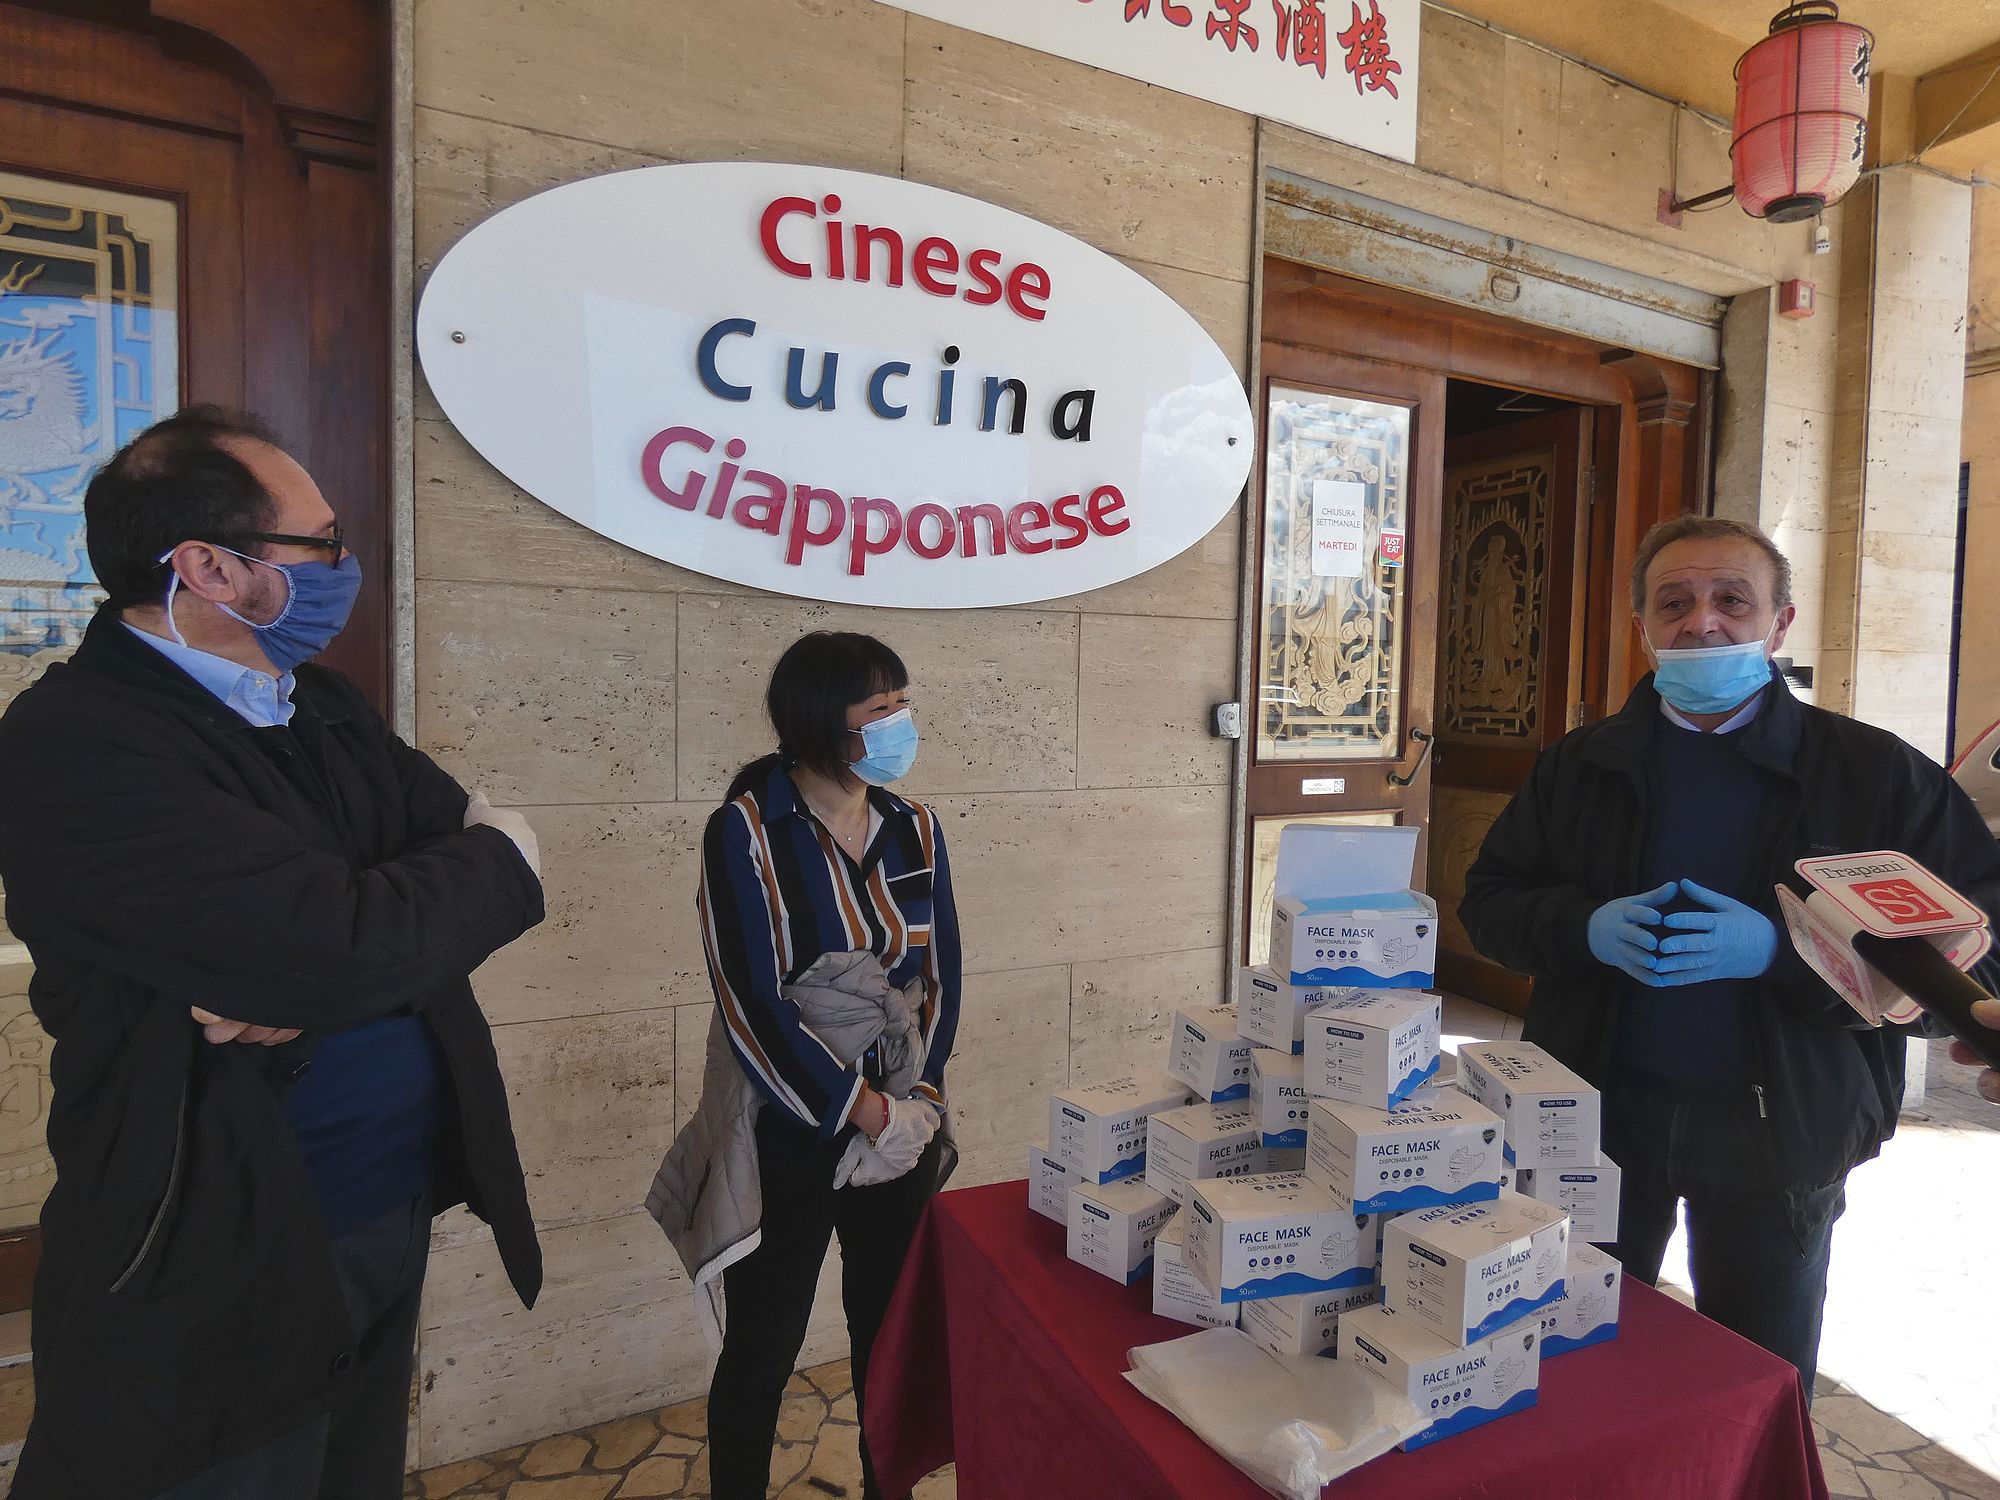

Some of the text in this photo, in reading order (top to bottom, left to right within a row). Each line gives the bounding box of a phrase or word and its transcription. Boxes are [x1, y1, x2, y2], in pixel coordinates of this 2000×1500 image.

[758, 194, 1053, 322] Cinese
[696, 317, 1097, 442] Cucina
[641, 425, 1131, 577] Giapponese
[1321, 507, 1356, 518] CHIUSURA
[1316, 518, 1361, 528] SETTIMANALE
[1384, 536, 1400, 546] JUST
[1387, 546, 1400, 554] EAT
[1815, 861, 1907, 879] Trapani
[1307, 926, 1375, 939] FACE MASK
[1304, 992, 1324, 1003] FACE
[1328, 987, 1351, 999] MASK
[1395, 1032, 1408, 1048] FACE
[1408, 1024, 1422, 1040] MASK
[1229, 1048, 1250, 1058] FACE
[1472, 1072, 1488, 1089] MASK
[1111, 1115, 1148, 1134] FACE MA
[1382, 1117, 1425, 1127] MASK
[1432, 1113, 1463, 1122] FACE
[1209, 1138, 1262, 1160] FACE MASK
[1372, 1140, 1441, 1158] FACE MASK
[1378, 1157, 1412, 1165] DISPOSABLE
[1228, 1176, 1259, 1185] FACE
[1266, 1172, 1304, 1180] MASK
[1137, 1214, 1156, 1232] FACE
[1418, 1209, 1444, 1222] FACE
[1239, 1226, 1312, 1244] FACE MASK
[1248, 1243, 1282, 1252] DISPOSABLE
[1481, 1249, 1533, 1280] FACE MASK
[1314, 1291, 1374, 1316] FACE MASK
[1422, 1356, 1488, 1386] FACE MASK
